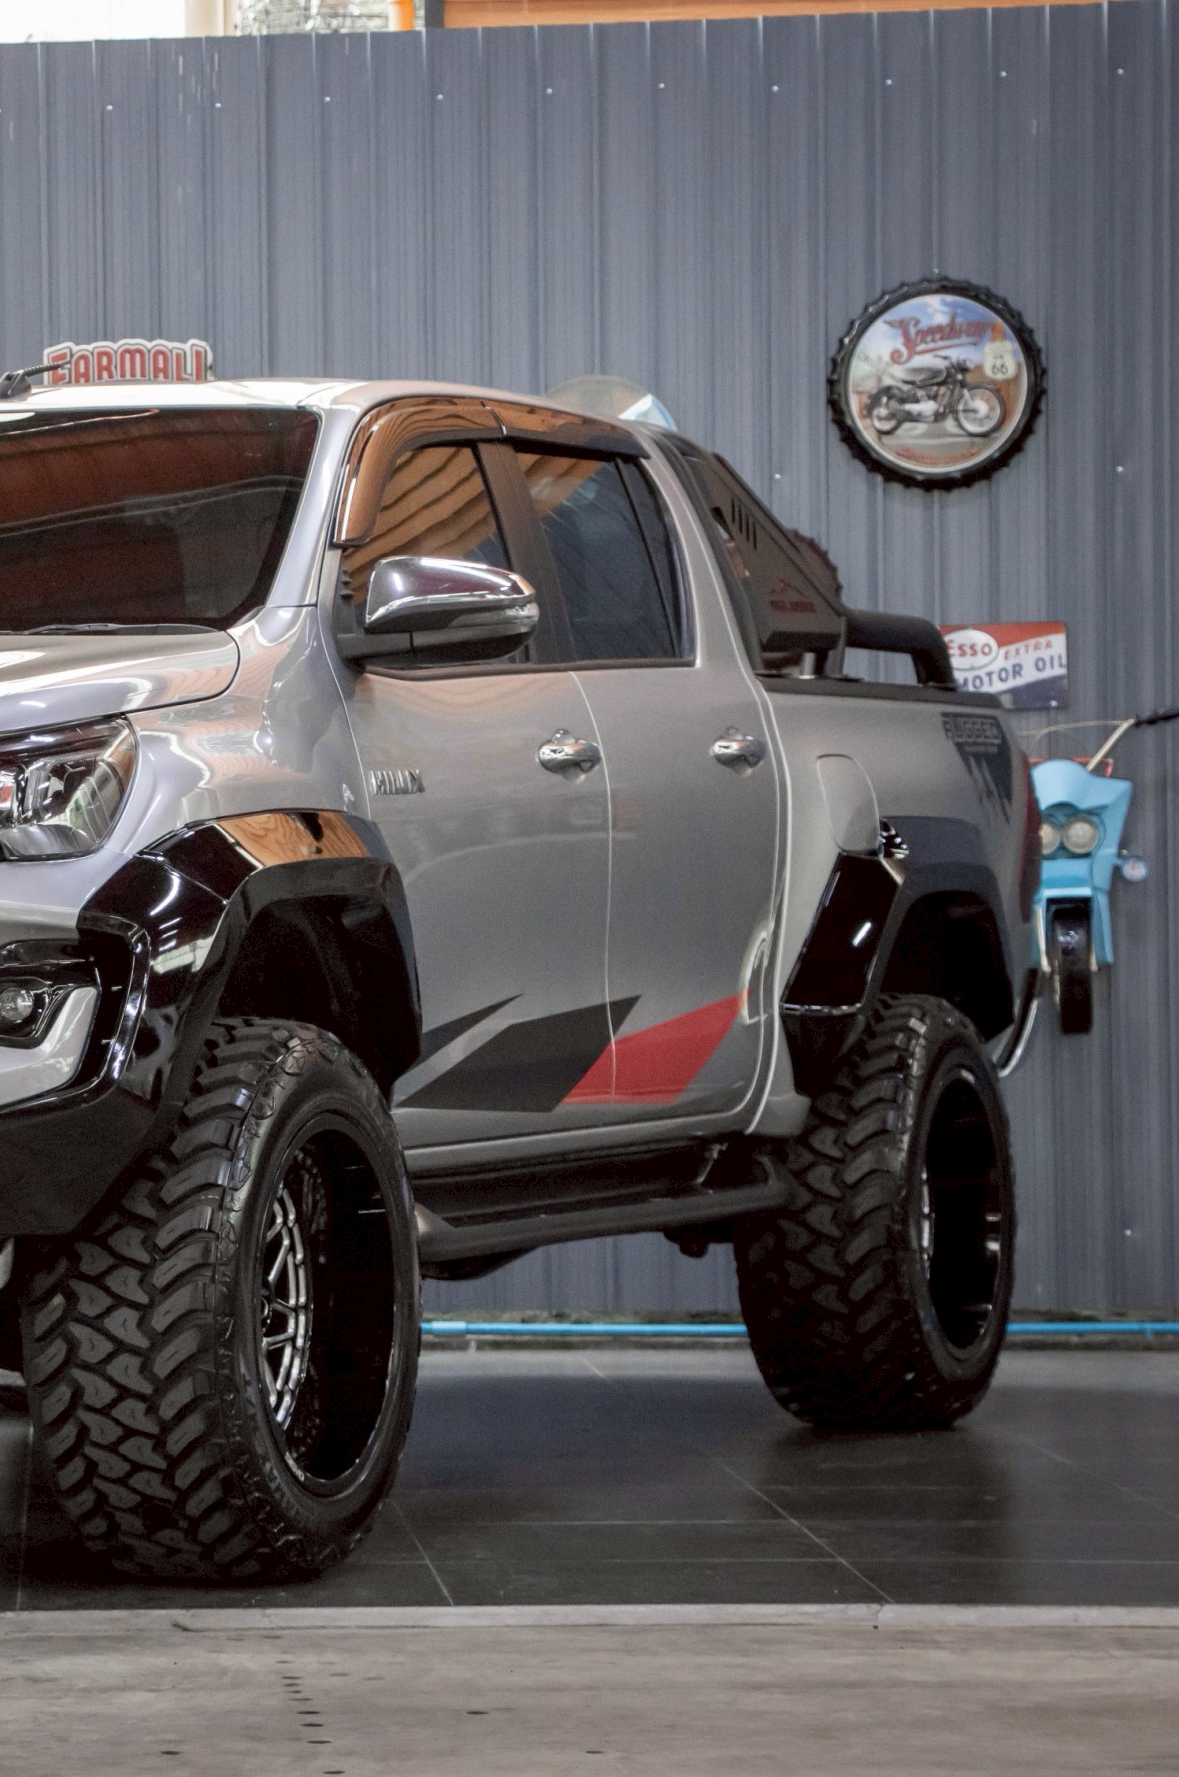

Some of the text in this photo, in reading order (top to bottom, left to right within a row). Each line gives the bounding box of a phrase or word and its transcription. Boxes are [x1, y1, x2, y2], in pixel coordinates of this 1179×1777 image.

[992, 362, 1009, 375] 66
[1003, 640, 1053, 661] EXTRA
[1035, 653, 1067, 672] OIL
